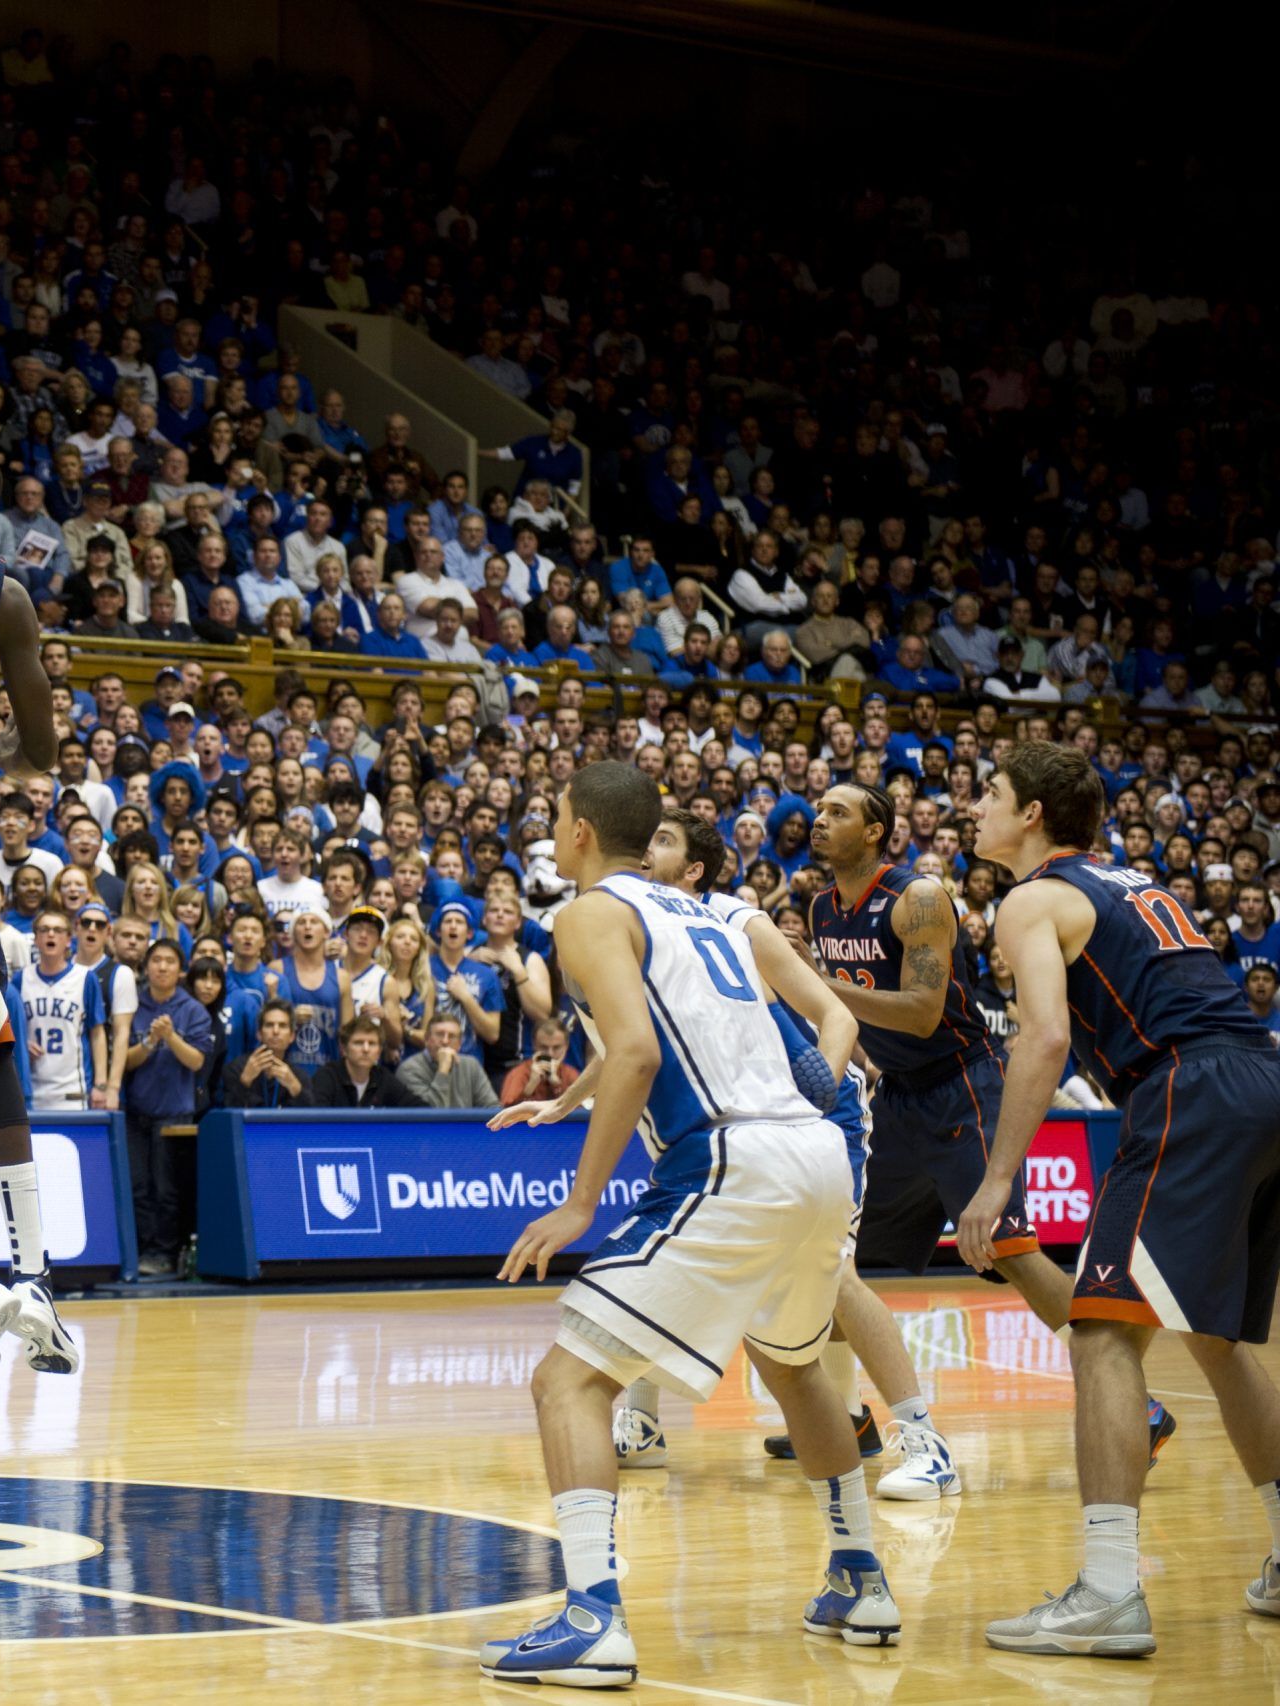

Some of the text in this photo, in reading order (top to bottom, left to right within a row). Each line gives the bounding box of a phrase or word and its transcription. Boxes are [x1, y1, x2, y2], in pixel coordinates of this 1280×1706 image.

[685, 925, 758, 1002] 0
[819, 936, 888, 962] VIRGINIA
[23, 996, 80, 1023] DUKE
[387, 1169, 650, 1209] DukeMediine
[1026, 1189, 1091, 1223] RTS
